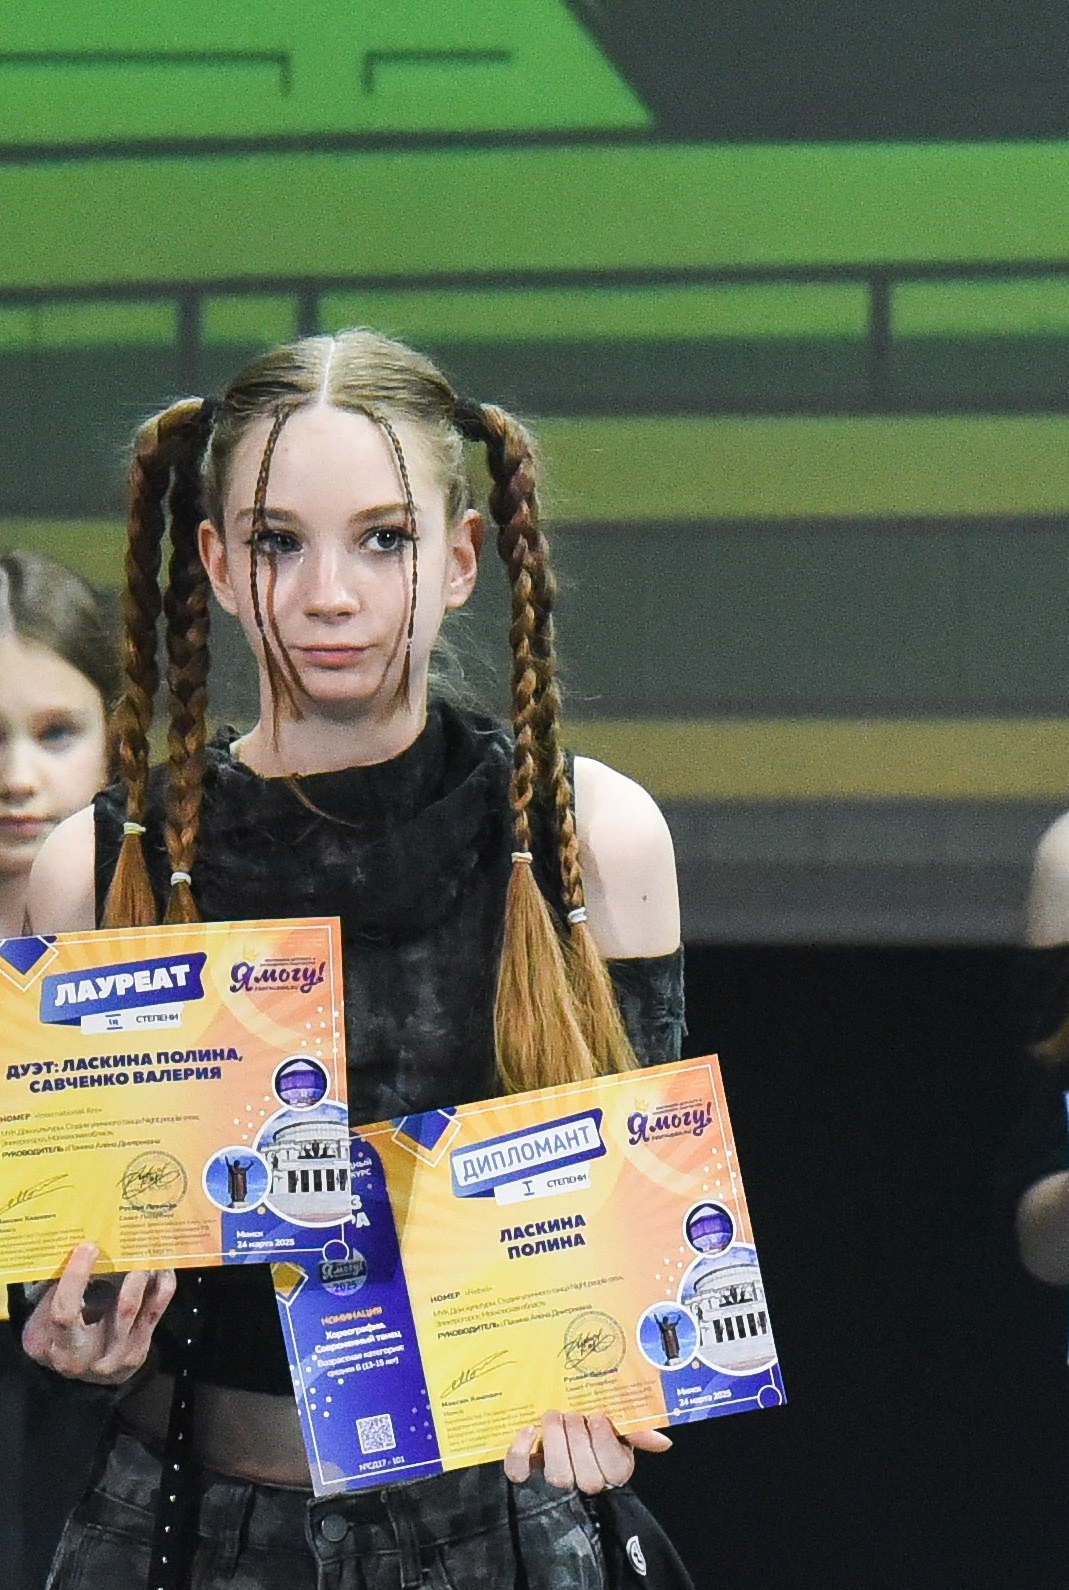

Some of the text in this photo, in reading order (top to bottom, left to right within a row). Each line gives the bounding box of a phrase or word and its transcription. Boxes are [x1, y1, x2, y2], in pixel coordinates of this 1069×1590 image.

[54, 964, 190, 1007] ЛАУРЕАТ
[5, 1048, 243, 1080] ДУЭТ: ЛАСКИНА ПОЛИНА,
[29, 1066, 222, 1093] САВЧЕНКО ВАЛЕРИЯ
[0, 1113, 31, 1123] НОМЕР
[463, 1125, 589, 1182] ДИПЛОМАНТ
[546, 1173, 587, 1188] СТЕПЕНИ
[499, 1214, 587, 1243] ЛАСКИНА
[507, 1233, 586, 1260] ПОЛИНА
[430, 1291, 460, 1303] НОМЕР
